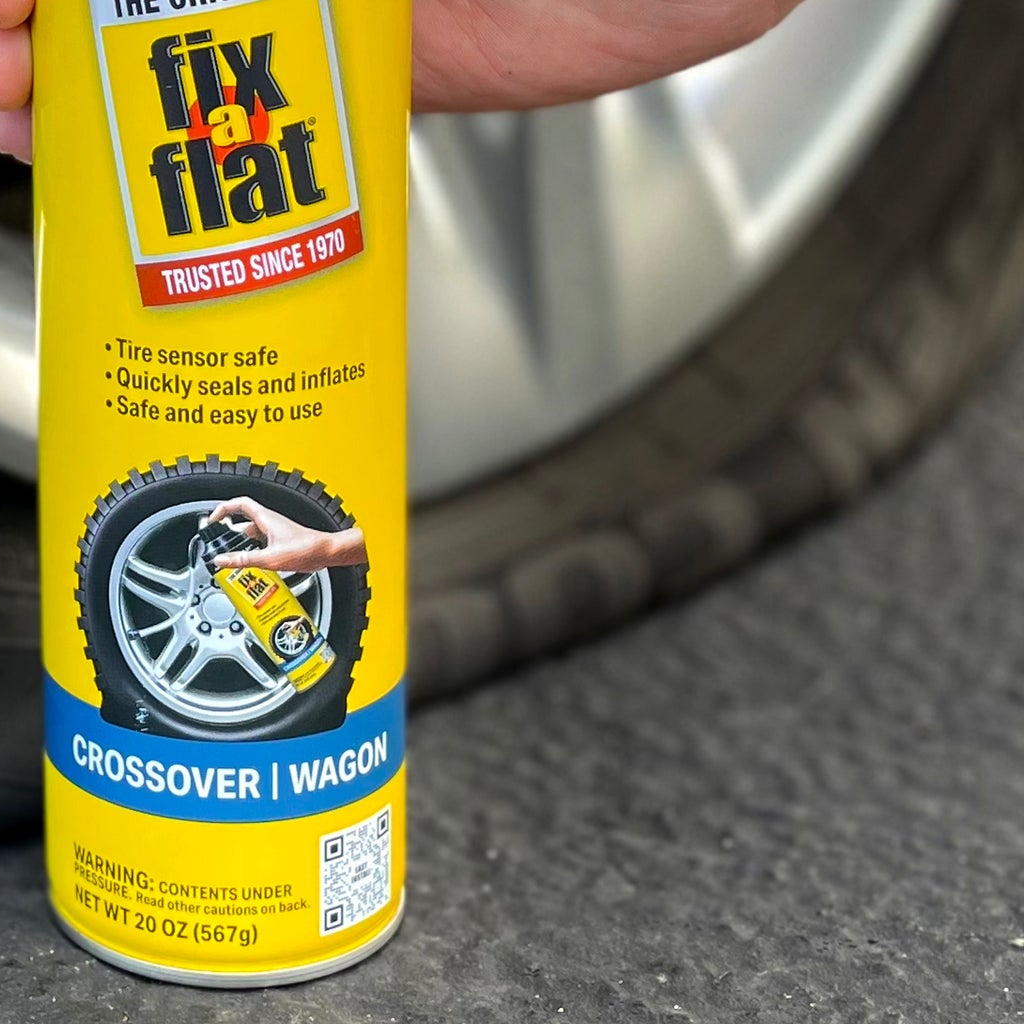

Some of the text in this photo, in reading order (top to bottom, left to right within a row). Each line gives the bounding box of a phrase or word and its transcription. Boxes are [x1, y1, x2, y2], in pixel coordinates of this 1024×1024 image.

[148, 29, 290, 131] fix
[207, 103, 252, 148] a
[161, 227, 347, 297] TRUSTED SINCE 1970
[115, 338, 279, 368] Tire sensor safe
[117, 360, 367, 400] Quickly seals and inflates
[117, 395, 324, 430] Safe and easy to use
[72, 734, 261, 800] CROSSOVER
[289, 731, 389, 795] WAGON
[73, 841, 293, 902] WARNING: CONTENTS UNDER
[74, 861, 312, 917] PRESSURE. Read other cautions on back.
[74, 883, 259, 948] NET WT 20 OZ (567g)
